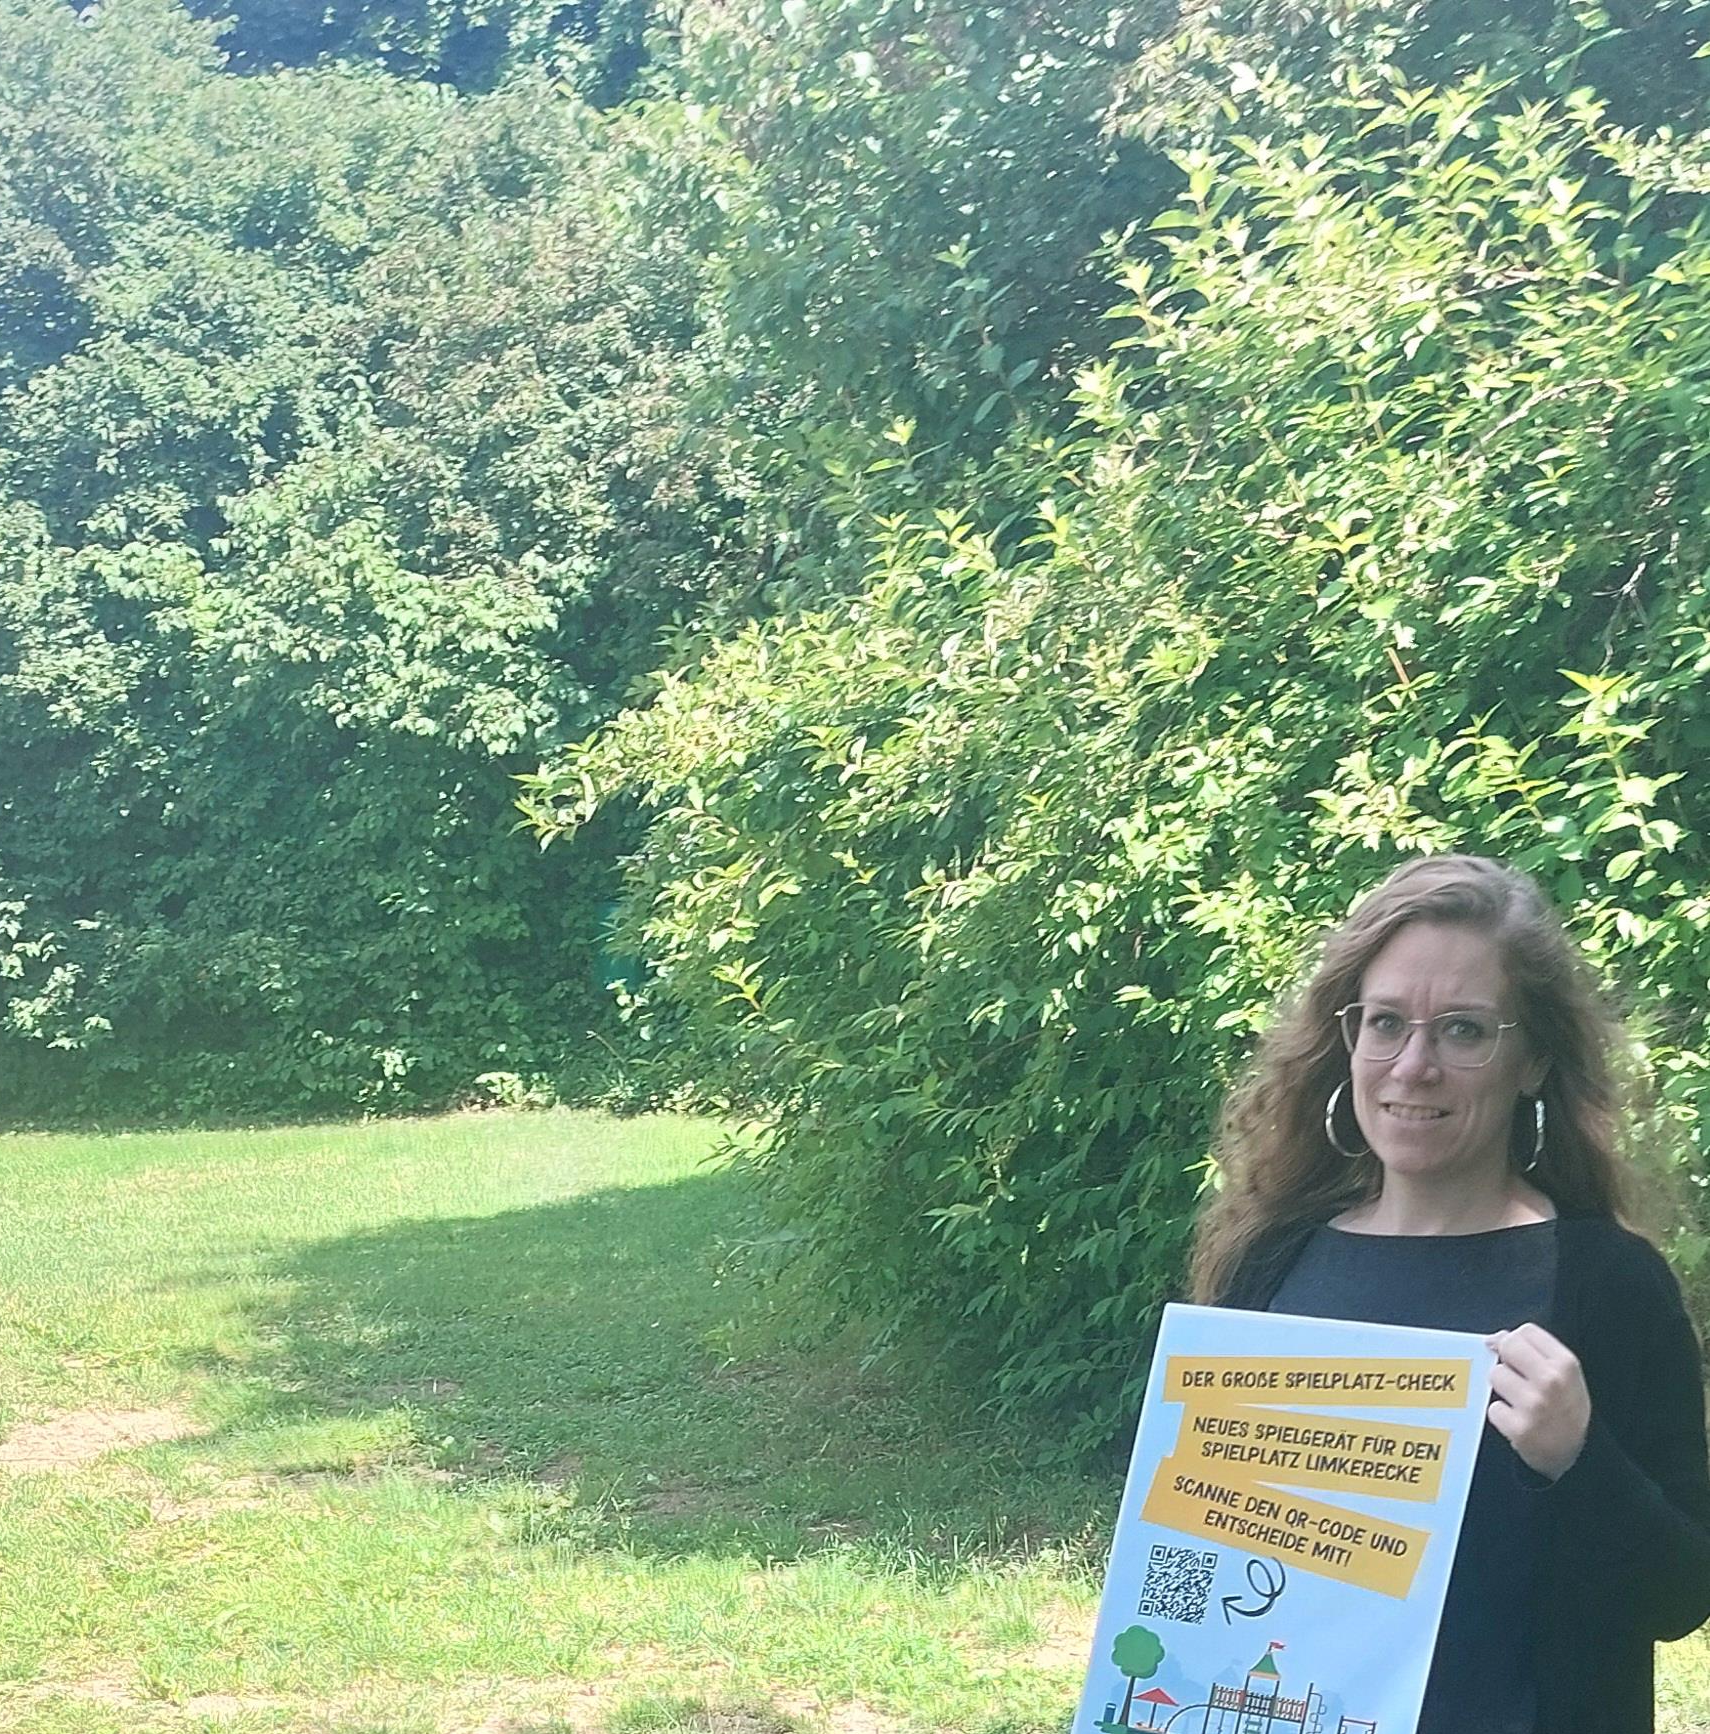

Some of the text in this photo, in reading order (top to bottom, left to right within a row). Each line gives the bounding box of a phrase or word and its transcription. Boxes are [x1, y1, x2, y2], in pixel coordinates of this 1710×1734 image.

[1182, 1371, 1214, 1388] DER
[1285, 1372, 1456, 1391] SPIELPLATZ-CHECK
[1193, 1416, 1441, 1461] NEUES SPIELGERÄT FÜR DEN
[1201, 1441, 1423, 1484] SPIELPLATZ LIMKERECKE
[1173, 1474, 1408, 1557] SCANNE DEN QR-CODE UND
[1204, 1509, 1353, 1568] ENTSCHEIDE MIT!
